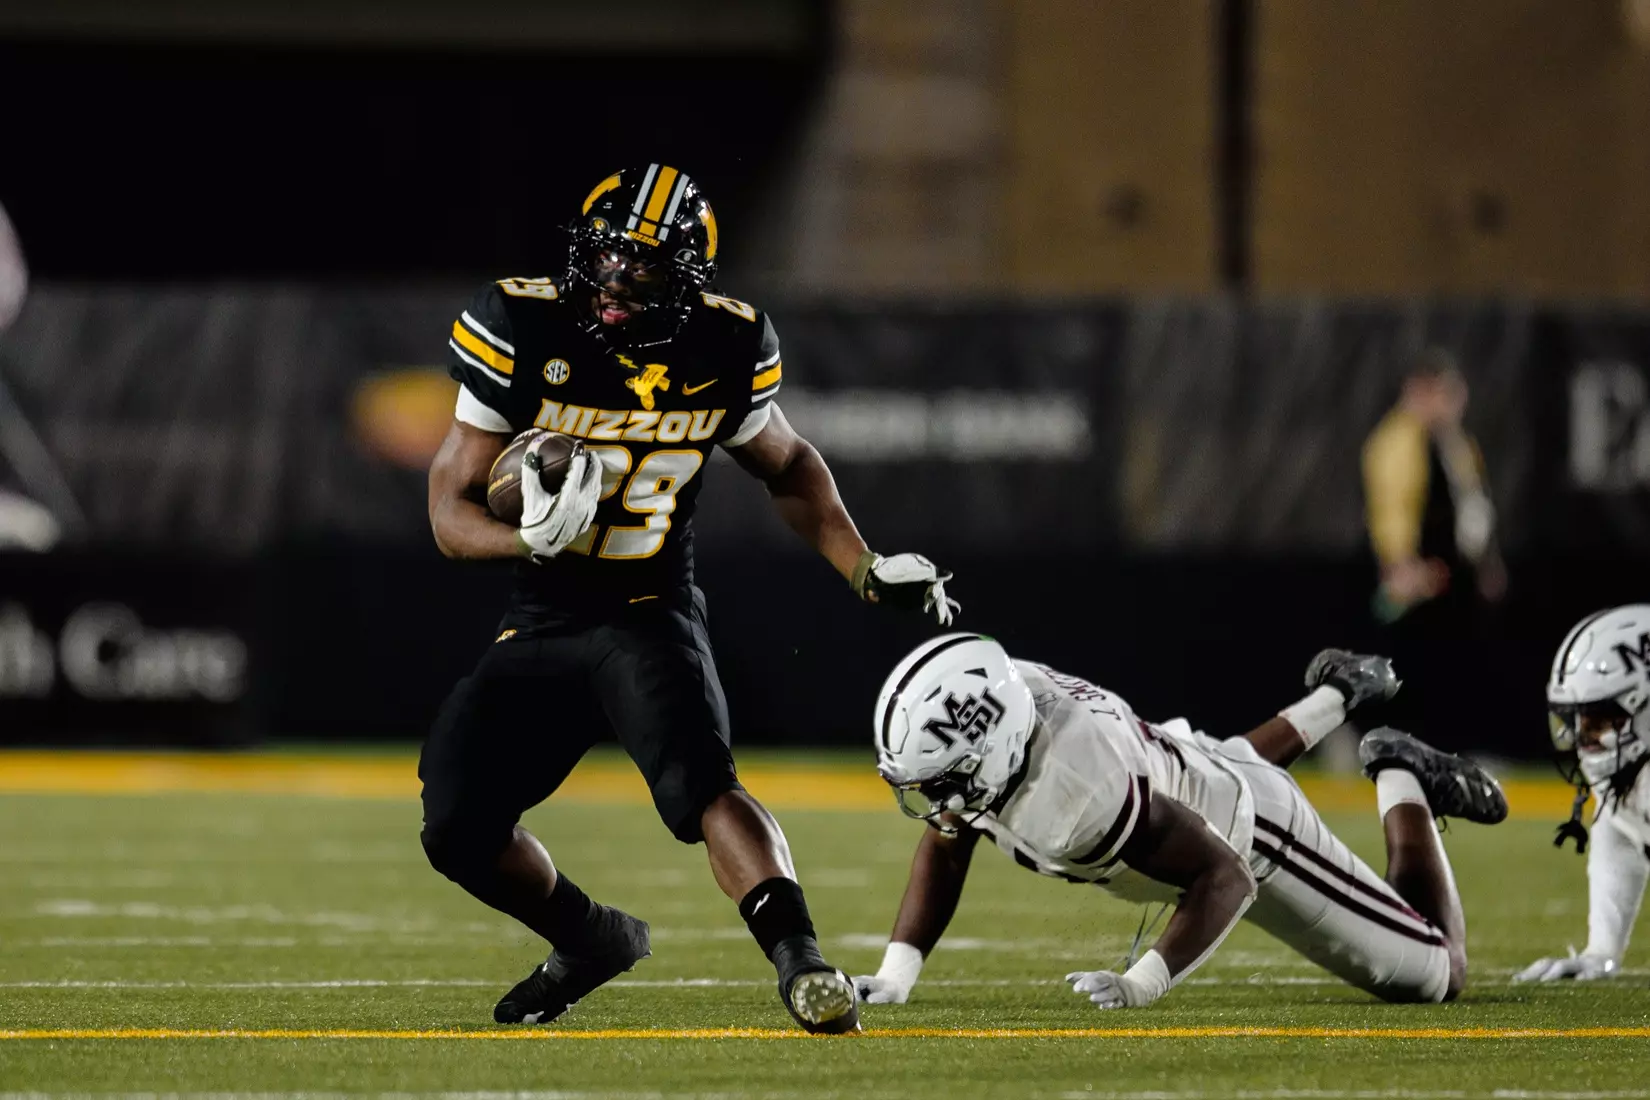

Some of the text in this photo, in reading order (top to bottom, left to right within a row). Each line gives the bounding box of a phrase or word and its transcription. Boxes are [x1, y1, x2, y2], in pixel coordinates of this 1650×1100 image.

[627, 230, 660, 247] MIZZOU
[545, 360, 568, 383] SEC
[533, 398, 727, 443] MIZZOU
[920, 686, 1007, 752] MSU
